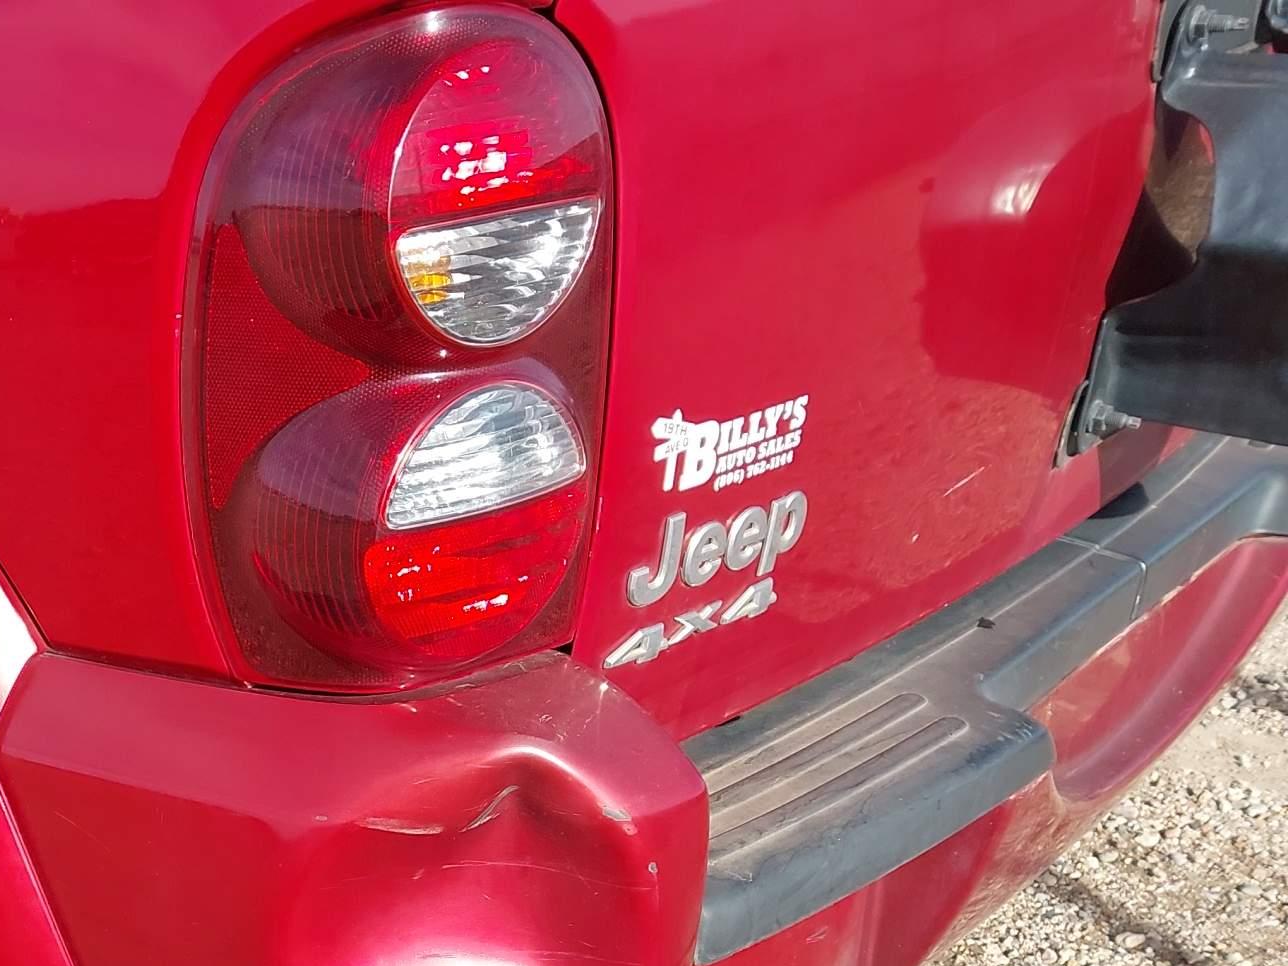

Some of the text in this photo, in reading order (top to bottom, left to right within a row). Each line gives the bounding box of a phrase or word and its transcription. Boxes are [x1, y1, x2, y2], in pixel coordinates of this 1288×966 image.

[663, 422, 688, 436] 19TH
[679, 394, 809, 492] BILLY'S
[715, 429, 803, 476] AUTO SALES
[626, 490, 808, 608] Jeep
